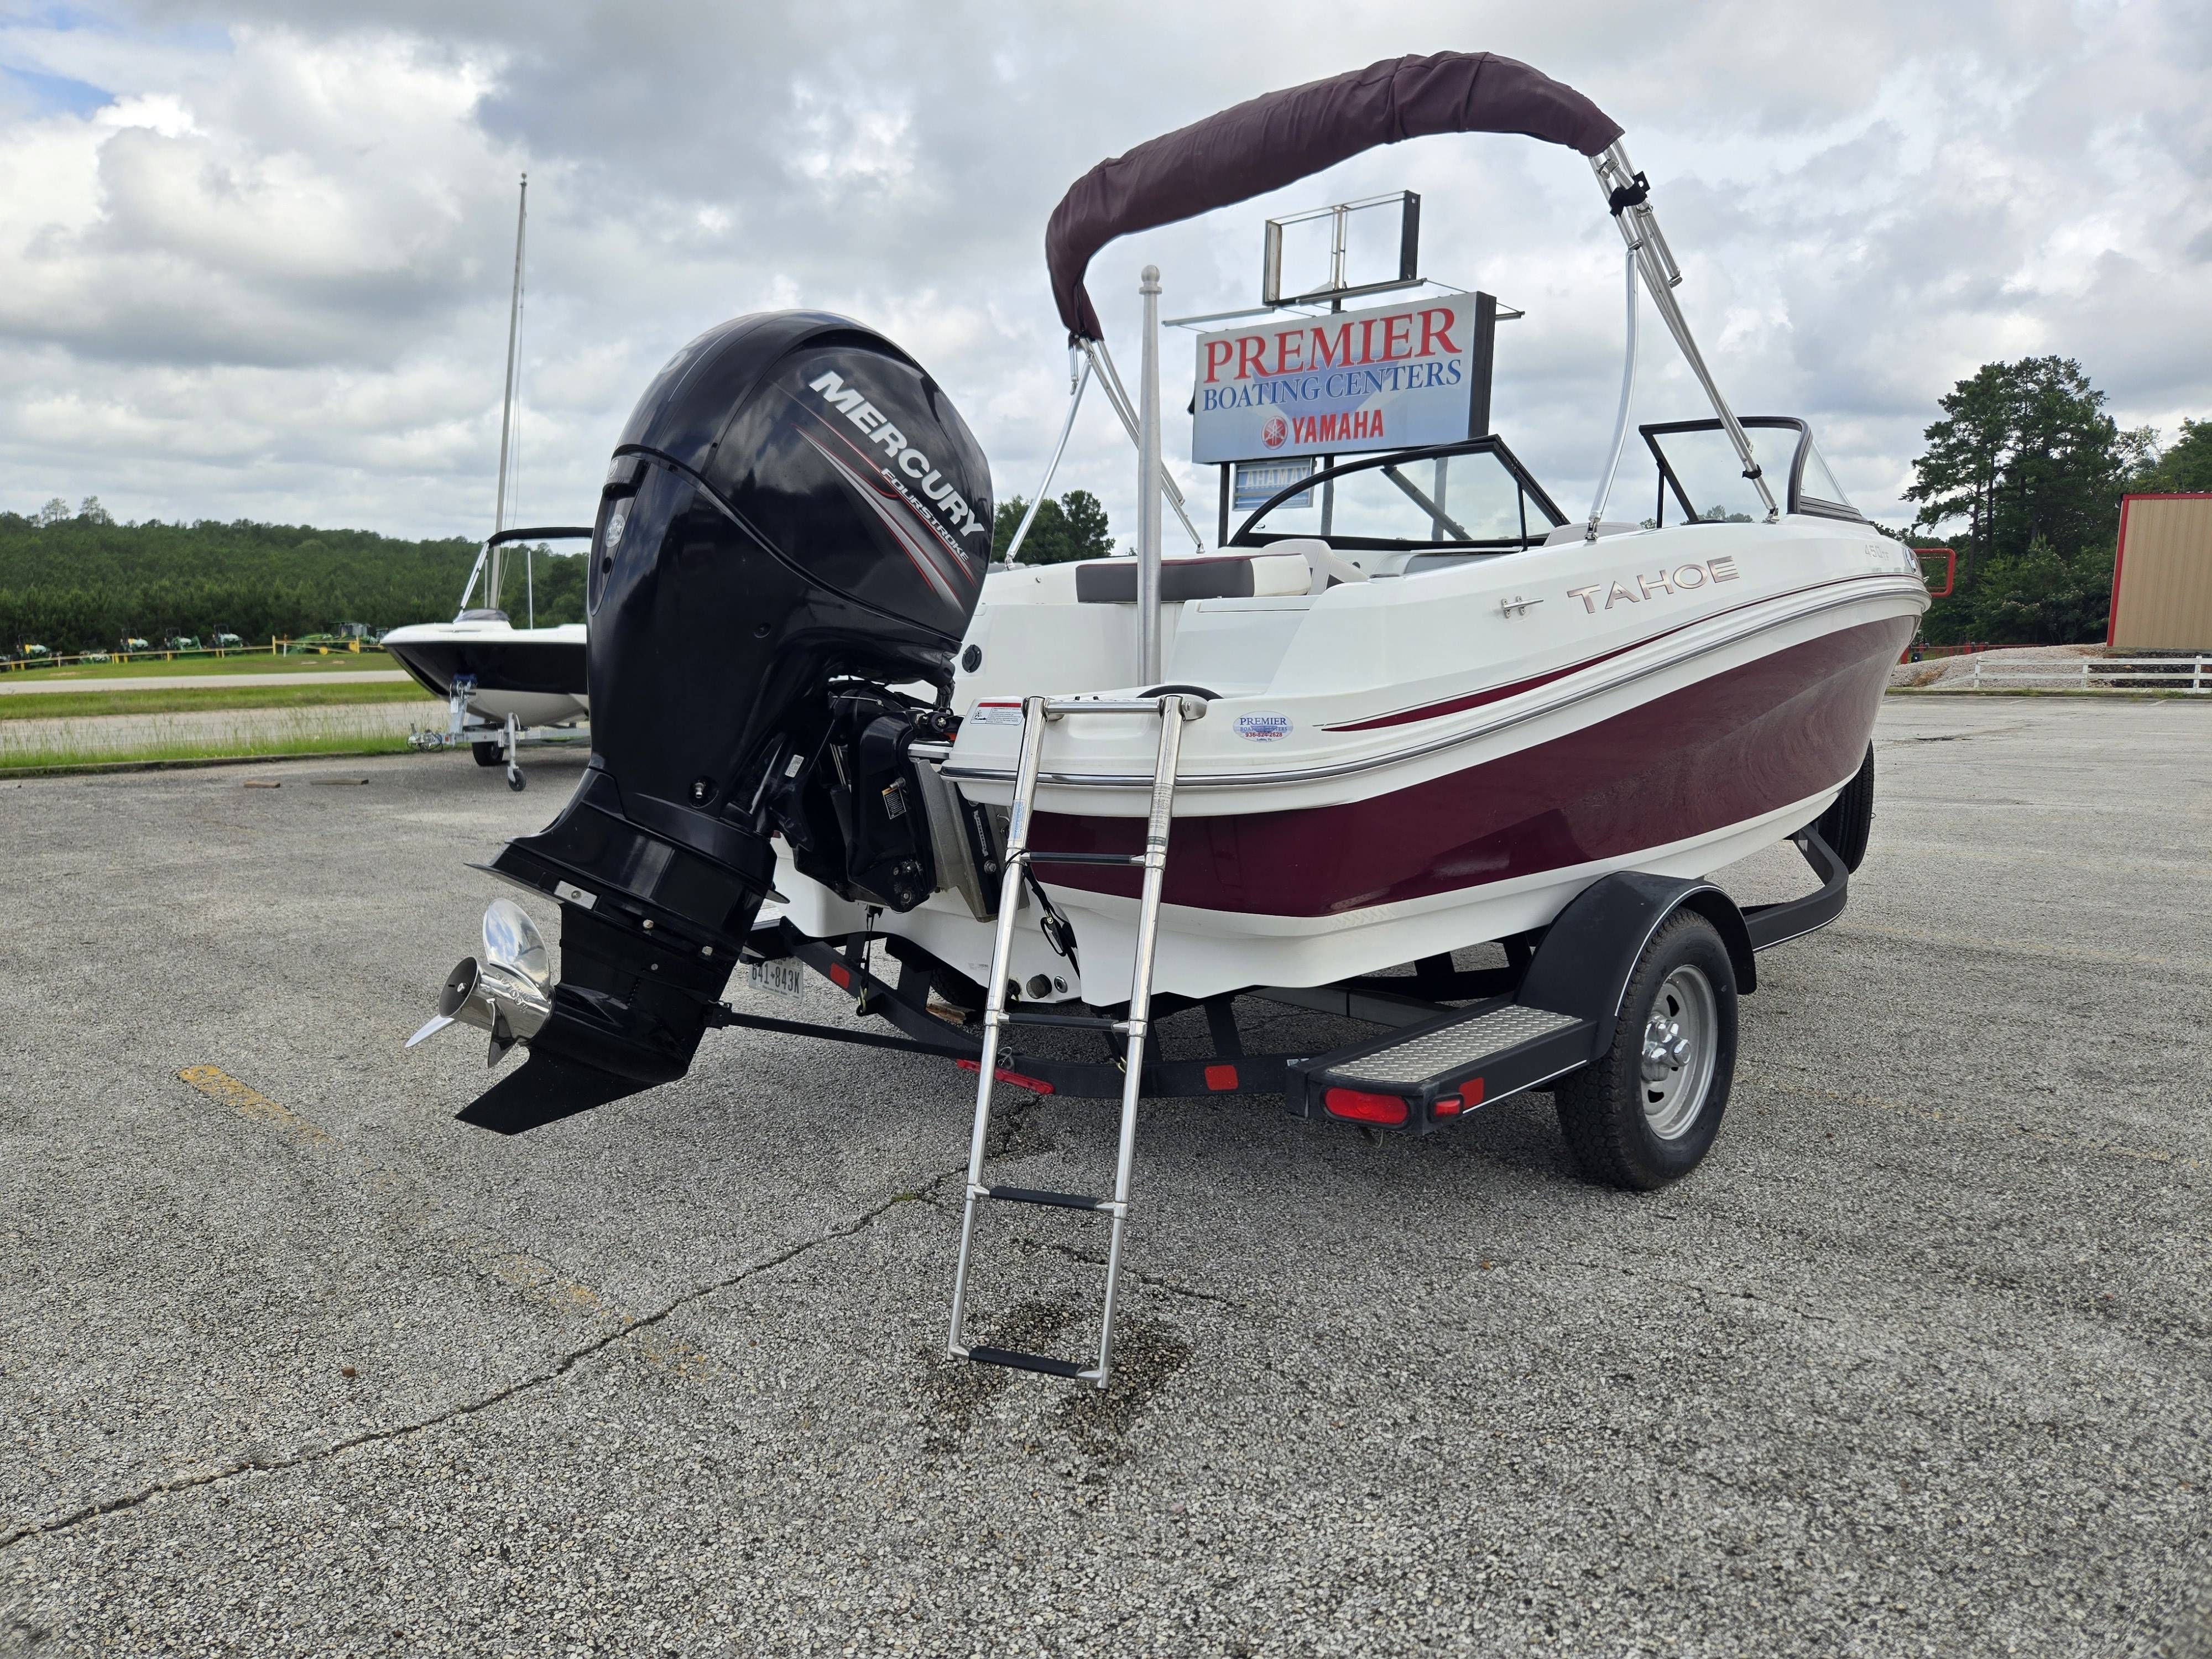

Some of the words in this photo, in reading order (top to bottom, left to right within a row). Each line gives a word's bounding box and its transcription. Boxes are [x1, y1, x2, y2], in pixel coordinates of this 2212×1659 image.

[1203, 307, 1462, 384] PREMIER
[1203, 375, 1321, 411] BOATING
[1325, 359, 1462, 398] CENTERS
[809, 371, 985, 538] MERCURY
[1292, 409, 1384, 444] YAMAHA
[880, 468, 969, 562] FOURSTROKE
[1567, 555, 1740, 614] TAHOE
[1239, 717, 1287, 726] PREMIER
